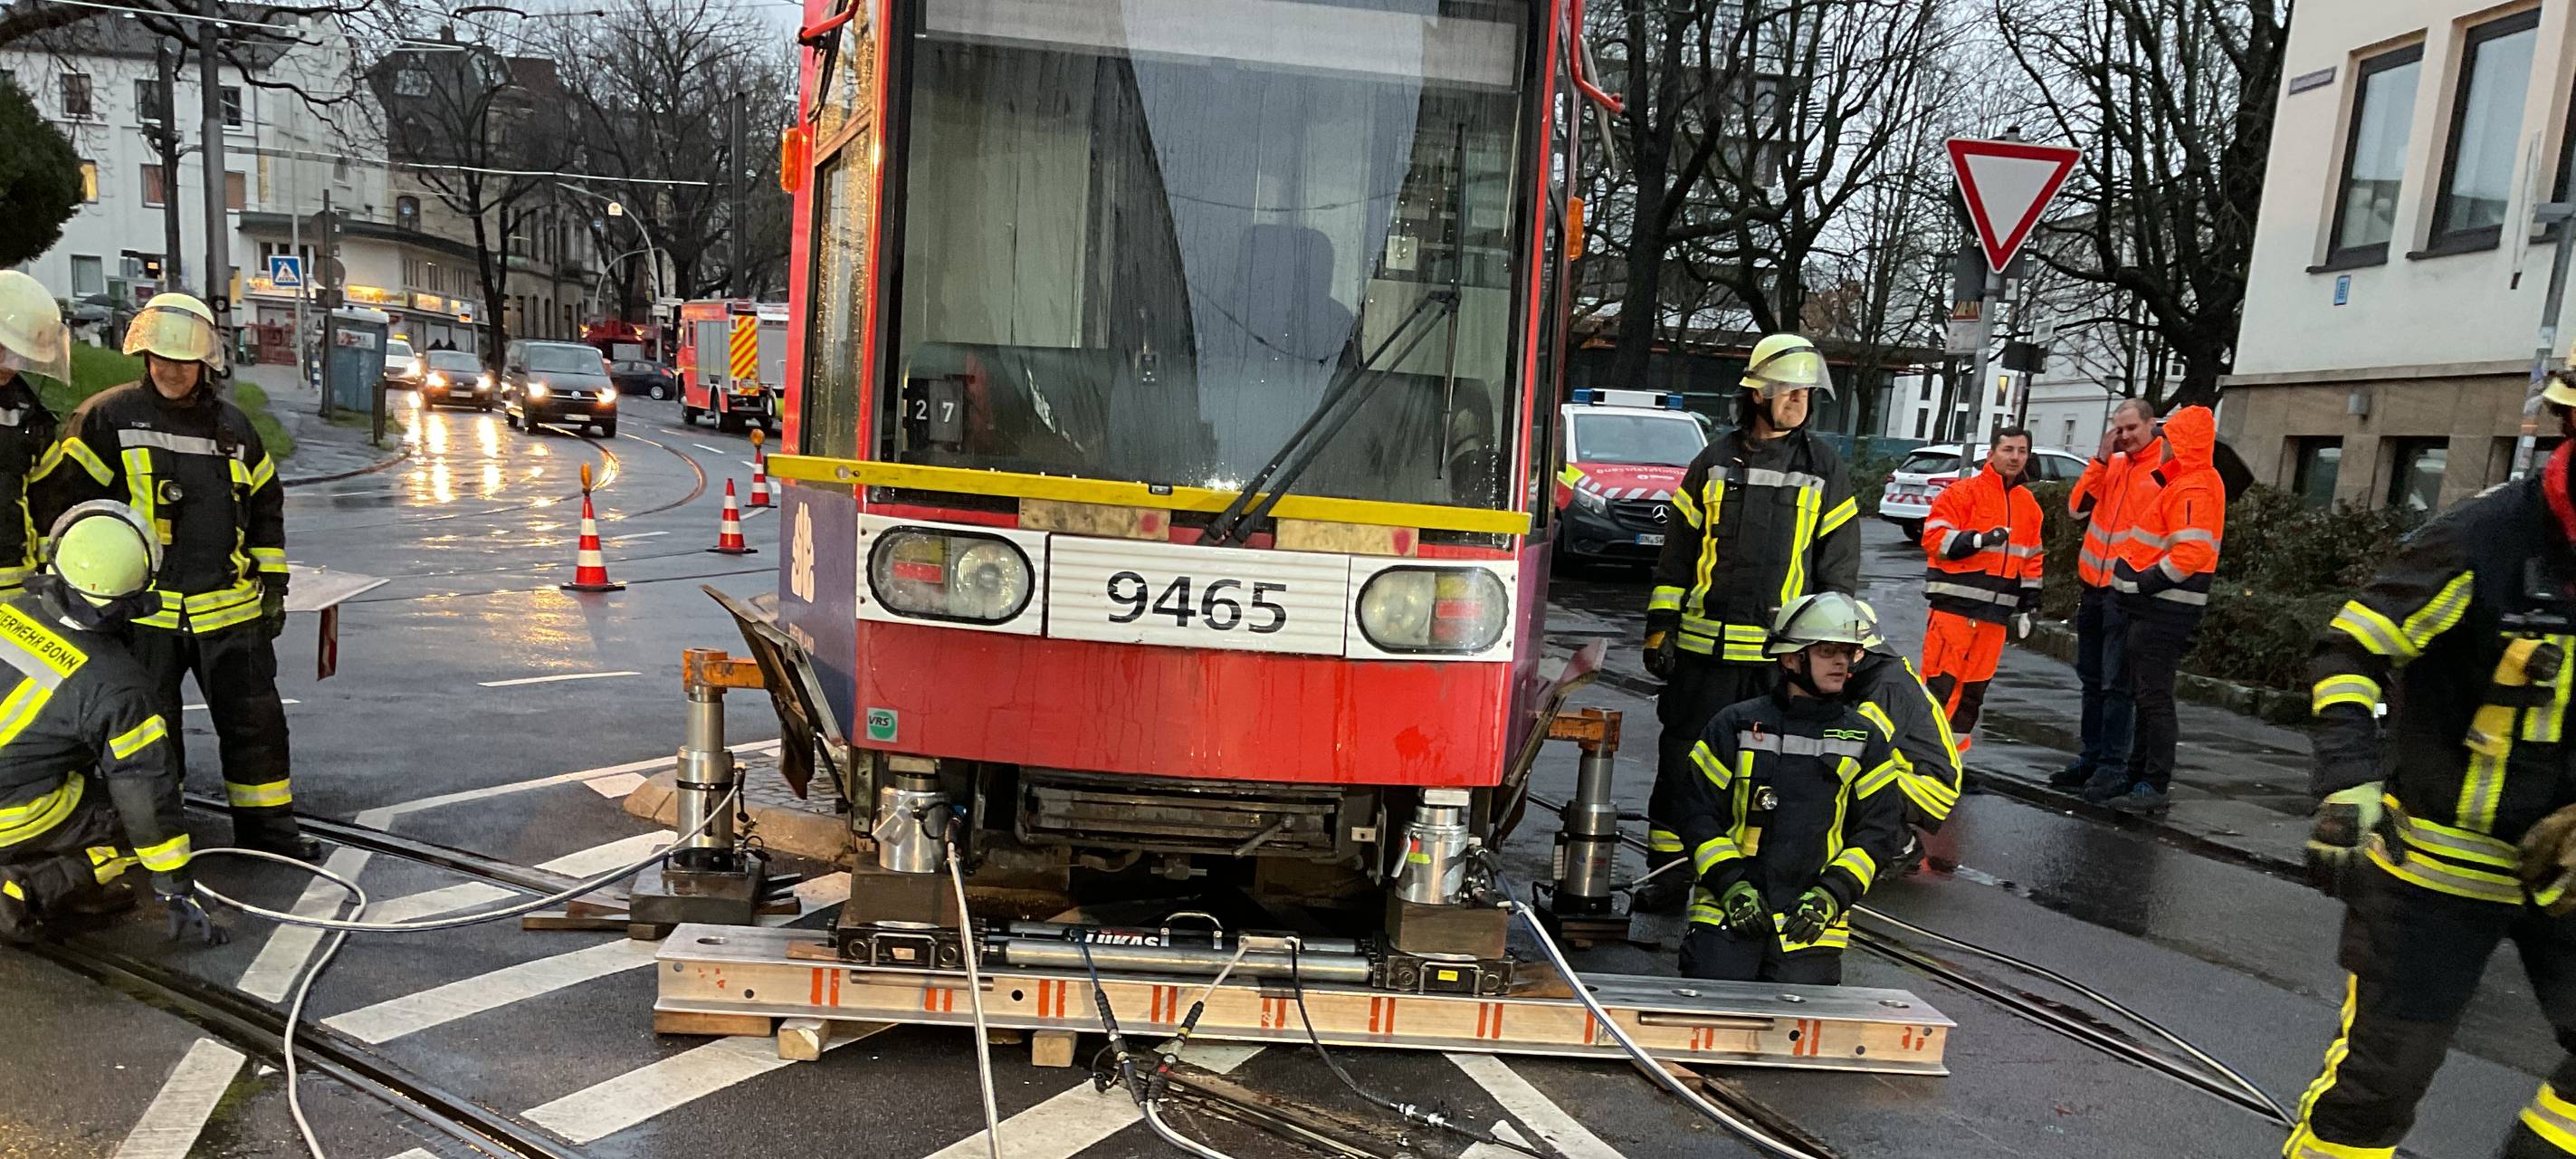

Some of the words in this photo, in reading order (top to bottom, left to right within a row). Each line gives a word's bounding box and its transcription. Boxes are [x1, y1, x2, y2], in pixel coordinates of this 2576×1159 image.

[1107, 571, 1286, 633] 9465
[39, 640, 81, 670] BONN
[869, 715, 890, 726] VRS
